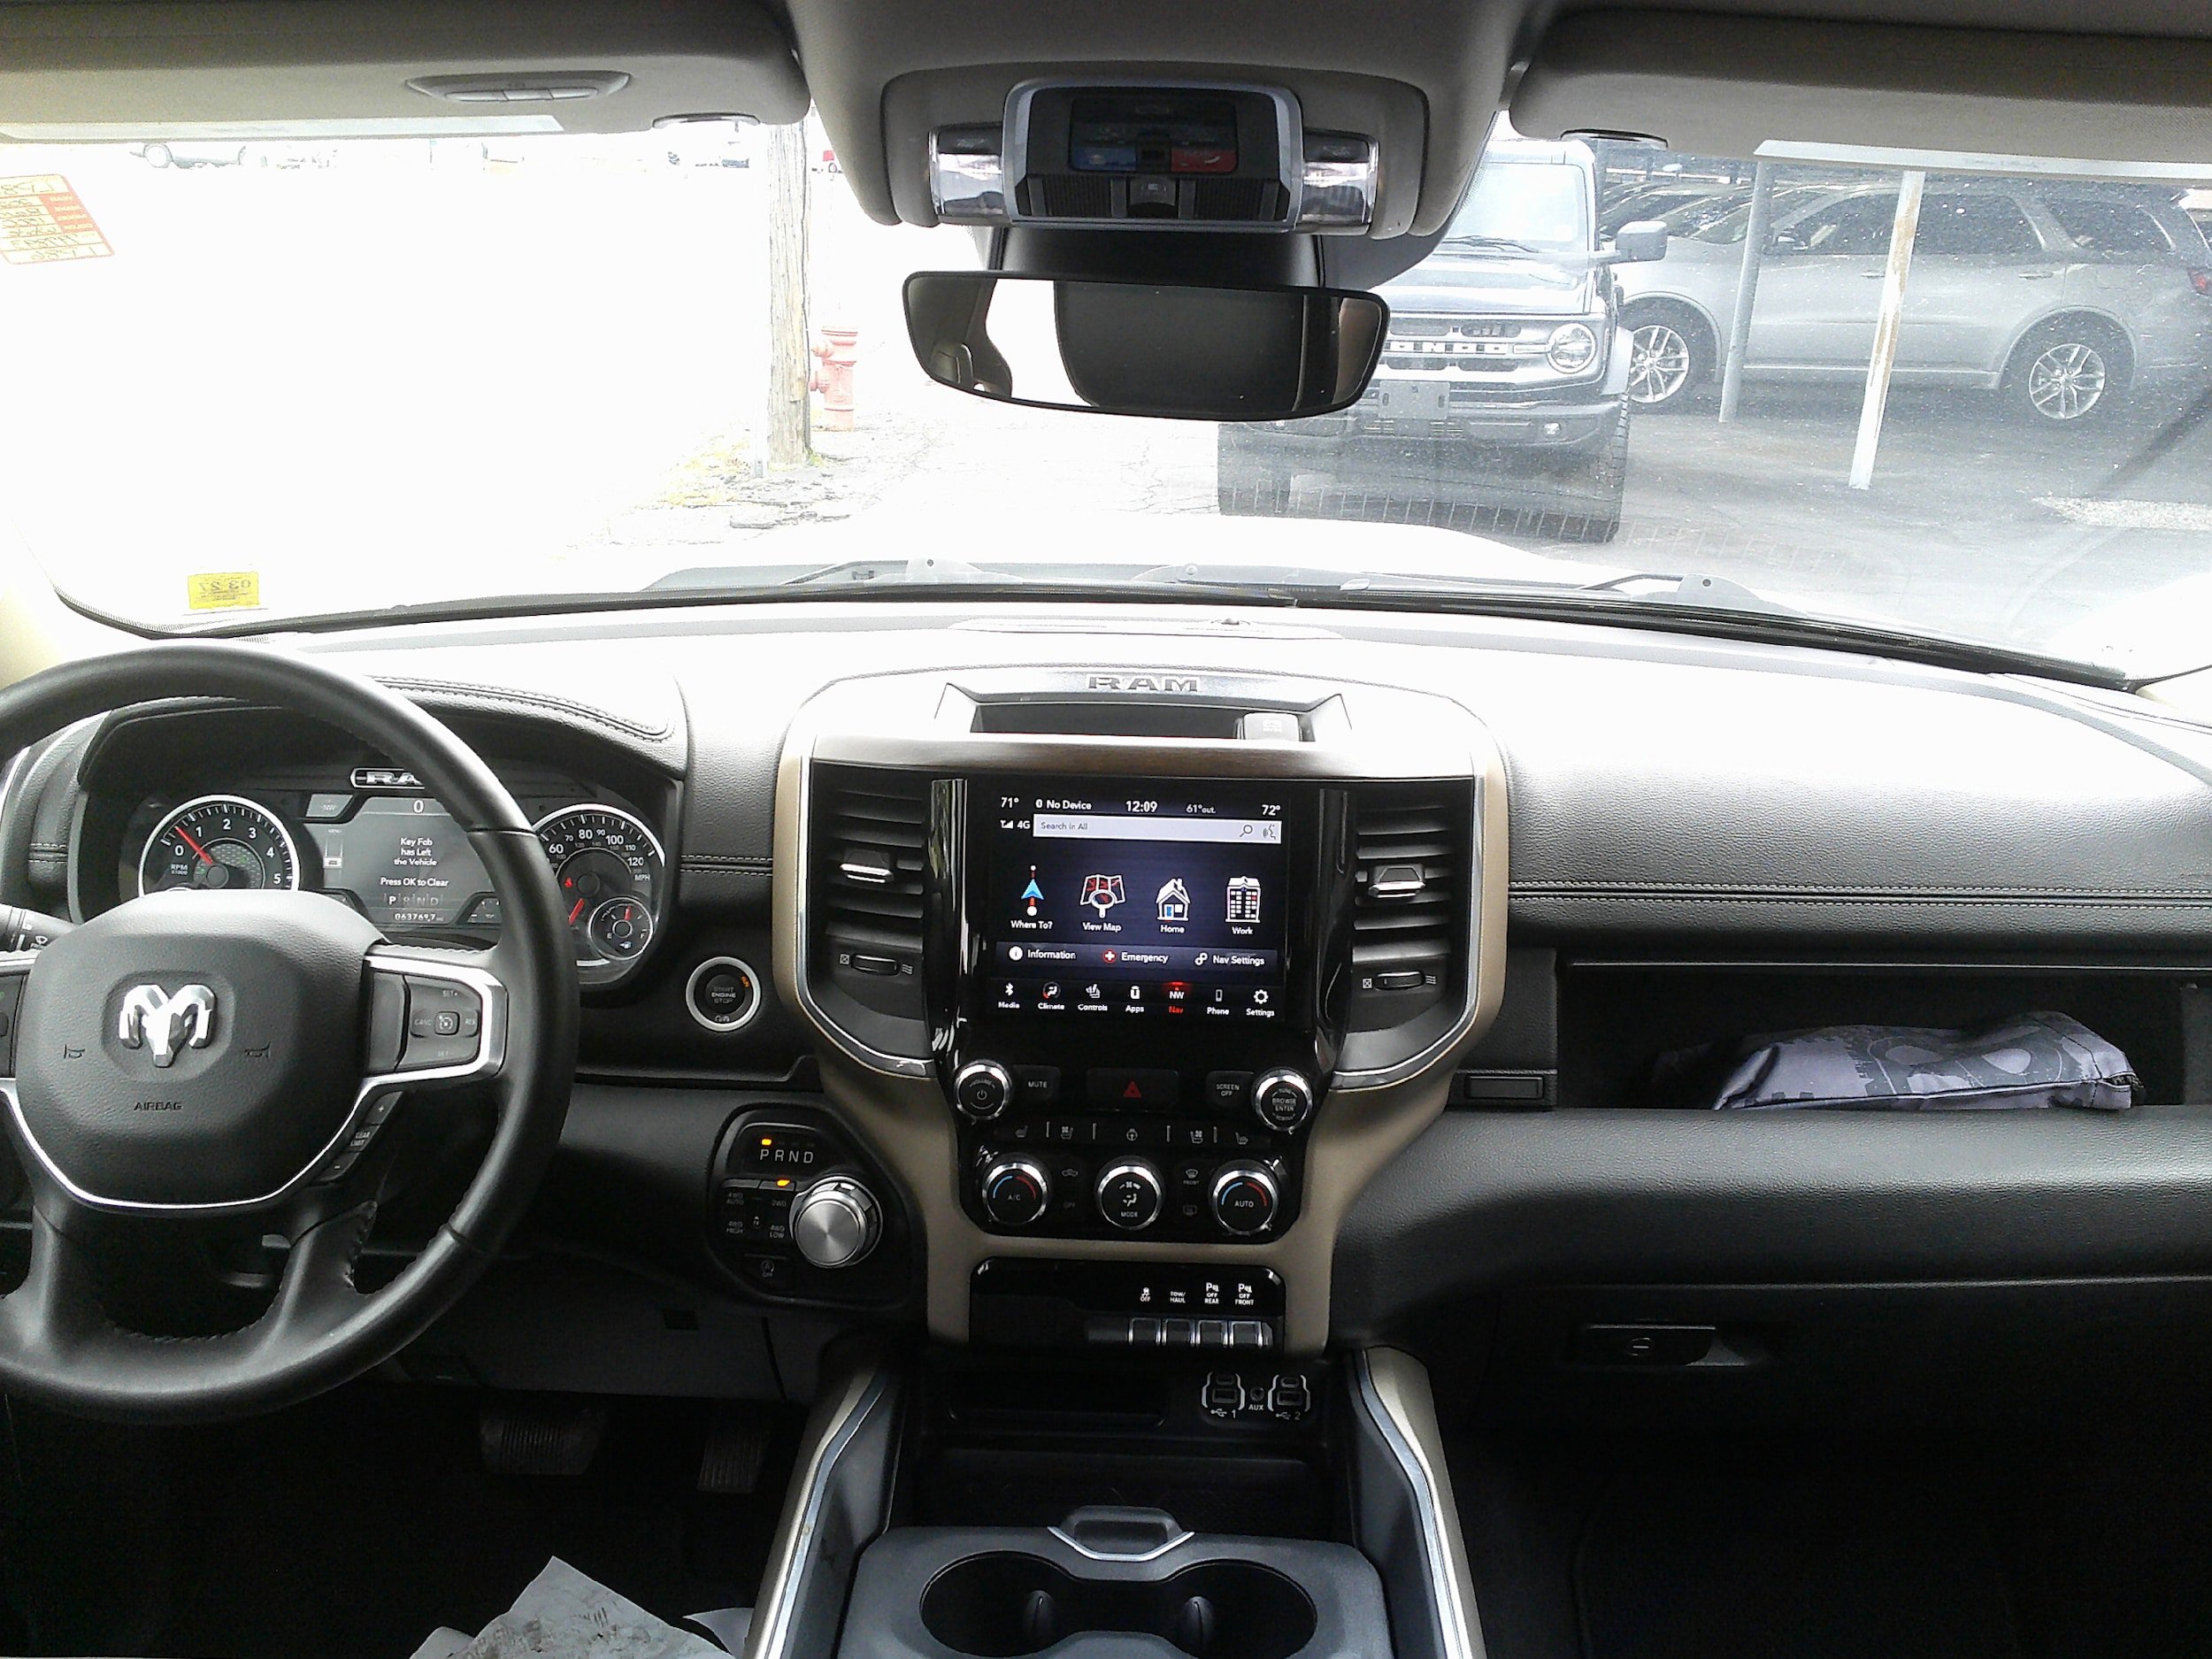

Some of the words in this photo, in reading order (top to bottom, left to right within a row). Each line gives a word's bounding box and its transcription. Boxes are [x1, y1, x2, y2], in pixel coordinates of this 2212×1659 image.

[1087, 675, 1200, 692] RAM
[365, 772, 424, 785] RA
[413, 800, 424, 813] 0
[1001, 797, 1019, 808] 71°
[1047, 800, 1060, 809] No
[1063, 800, 1092, 810] Device
[1126, 801, 1157, 812] 12:09
[1262, 804, 1280, 815] 72°
[223, 818, 231, 829] 2
[1017, 820, 1030, 829] 4G
[196, 827, 203, 837] 1
[249, 827, 257, 839] 3
[579, 829, 593, 839] 80
[400, 838, 416, 847] Key
[605, 835, 624, 845] 100
[175, 845, 184, 856] 0
[266, 847, 274, 858] 4
[549, 844, 564, 854] 60
[409, 857, 438, 866] Vehicle
[627, 857, 644, 866] 120
[273, 873, 281, 884] 5
[380, 877, 402, 886] Press
[403, 877, 417, 886] OK
[427, 878, 449, 887] Clear
[389, 895, 396, 904] P
[1038, 920, 1053, 929] To?
[1082, 922, 1102, 931] View
[1103, 923, 1122, 933] Map
[1160, 925, 1185, 933] Home
[1027, 949, 1076, 959] Information
[1121, 952, 1169, 964] Emergency
[1213, 955, 1229, 964] Nav
[1231, 956, 1264, 966] Settings
[1207, 1006, 1229, 1015] Phone
[1246, 1008, 1275, 1018] Settings
[134, 1102, 182, 1110] AIRBAG
[760, 1149, 769, 1160] P
[775, 1150, 785, 1162] R
[788, 1151, 799, 1163] N
[803, 1152, 814, 1164] D
[1231, 1409, 1236, 1418] 1
